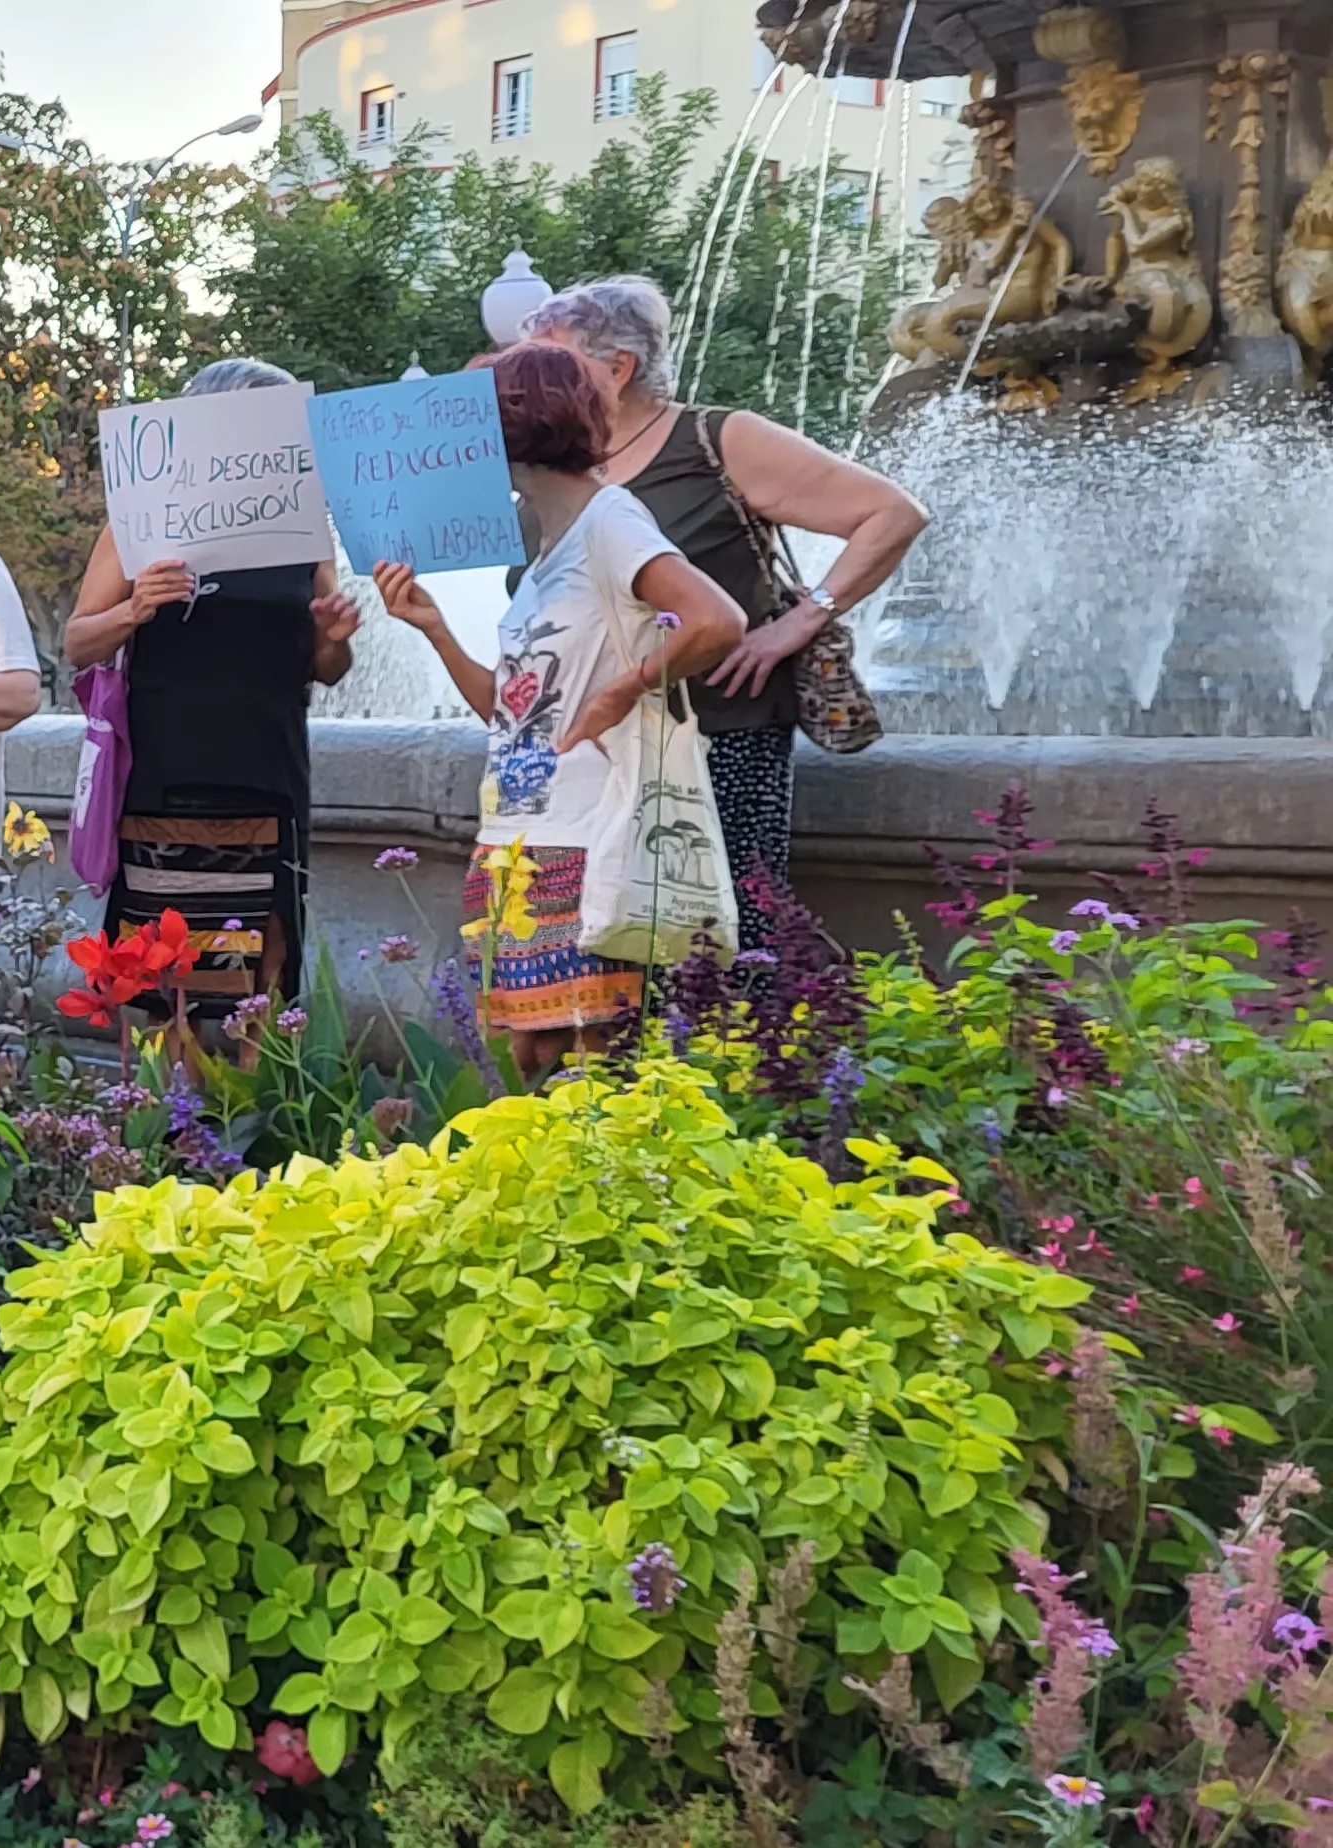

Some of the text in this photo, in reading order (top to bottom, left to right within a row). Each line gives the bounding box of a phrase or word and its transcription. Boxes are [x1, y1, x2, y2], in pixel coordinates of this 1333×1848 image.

[208, 444, 314, 483] DESCARTE
[354, 429, 500, 486] REDUCCIÓN
[164, 479, 304, 540] EXCLUSIÓN
[371, 491, 399, 519] LA
[429, 515, 521, 563] LABORAL
